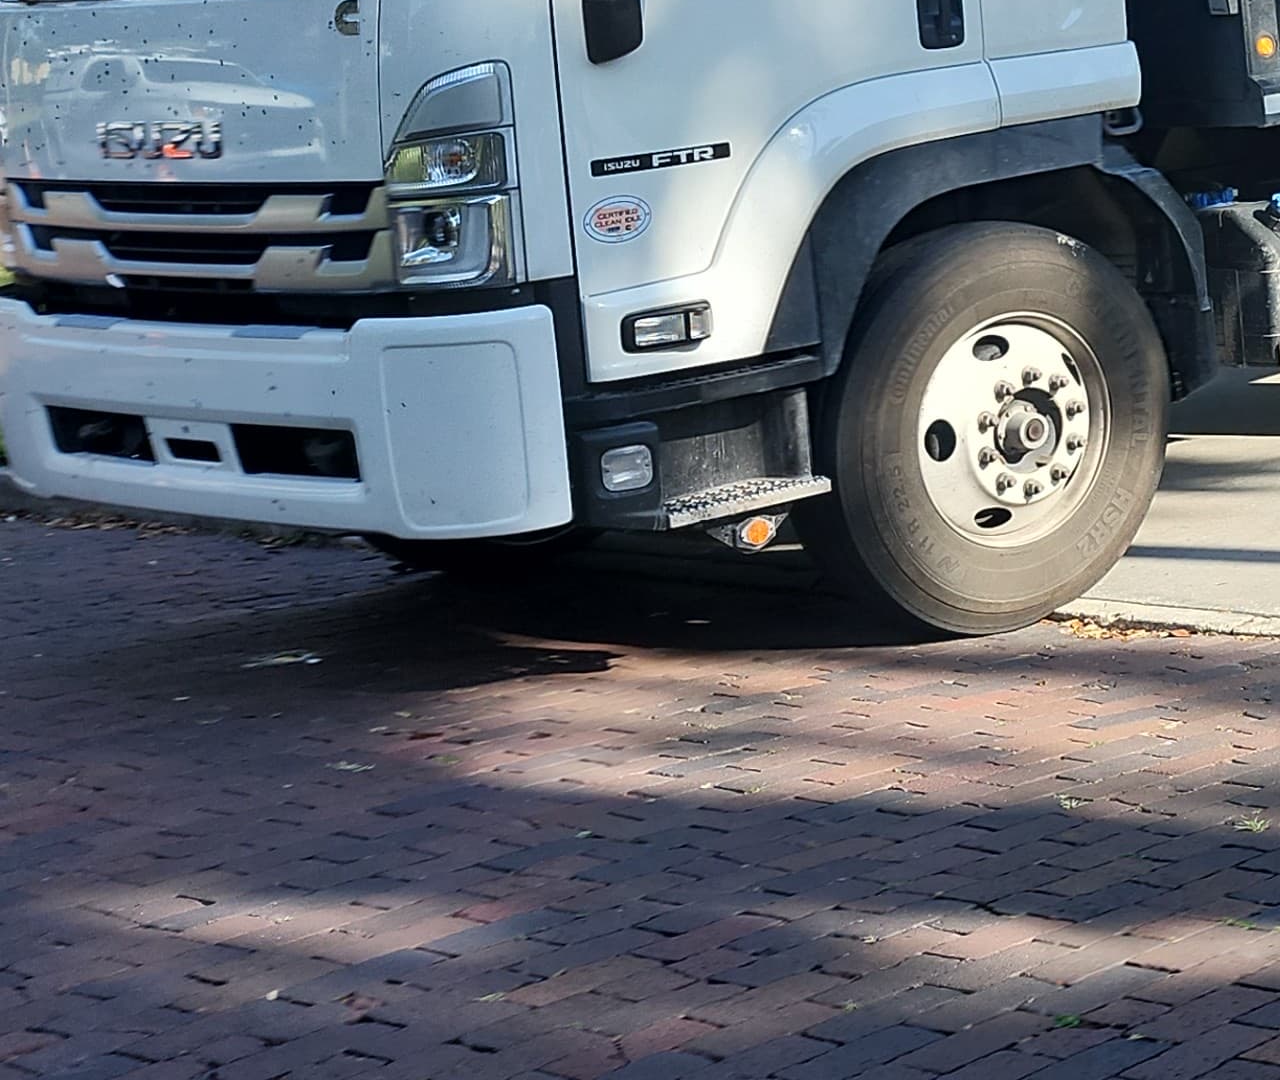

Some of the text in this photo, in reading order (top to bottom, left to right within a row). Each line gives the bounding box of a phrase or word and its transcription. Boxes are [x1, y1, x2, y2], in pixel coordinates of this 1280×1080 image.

[96, 120, 221, 159] ISUZU
[603, 146, 715, 171] ISUZU FTR
[594, 218, 622, 228] CLEAN
